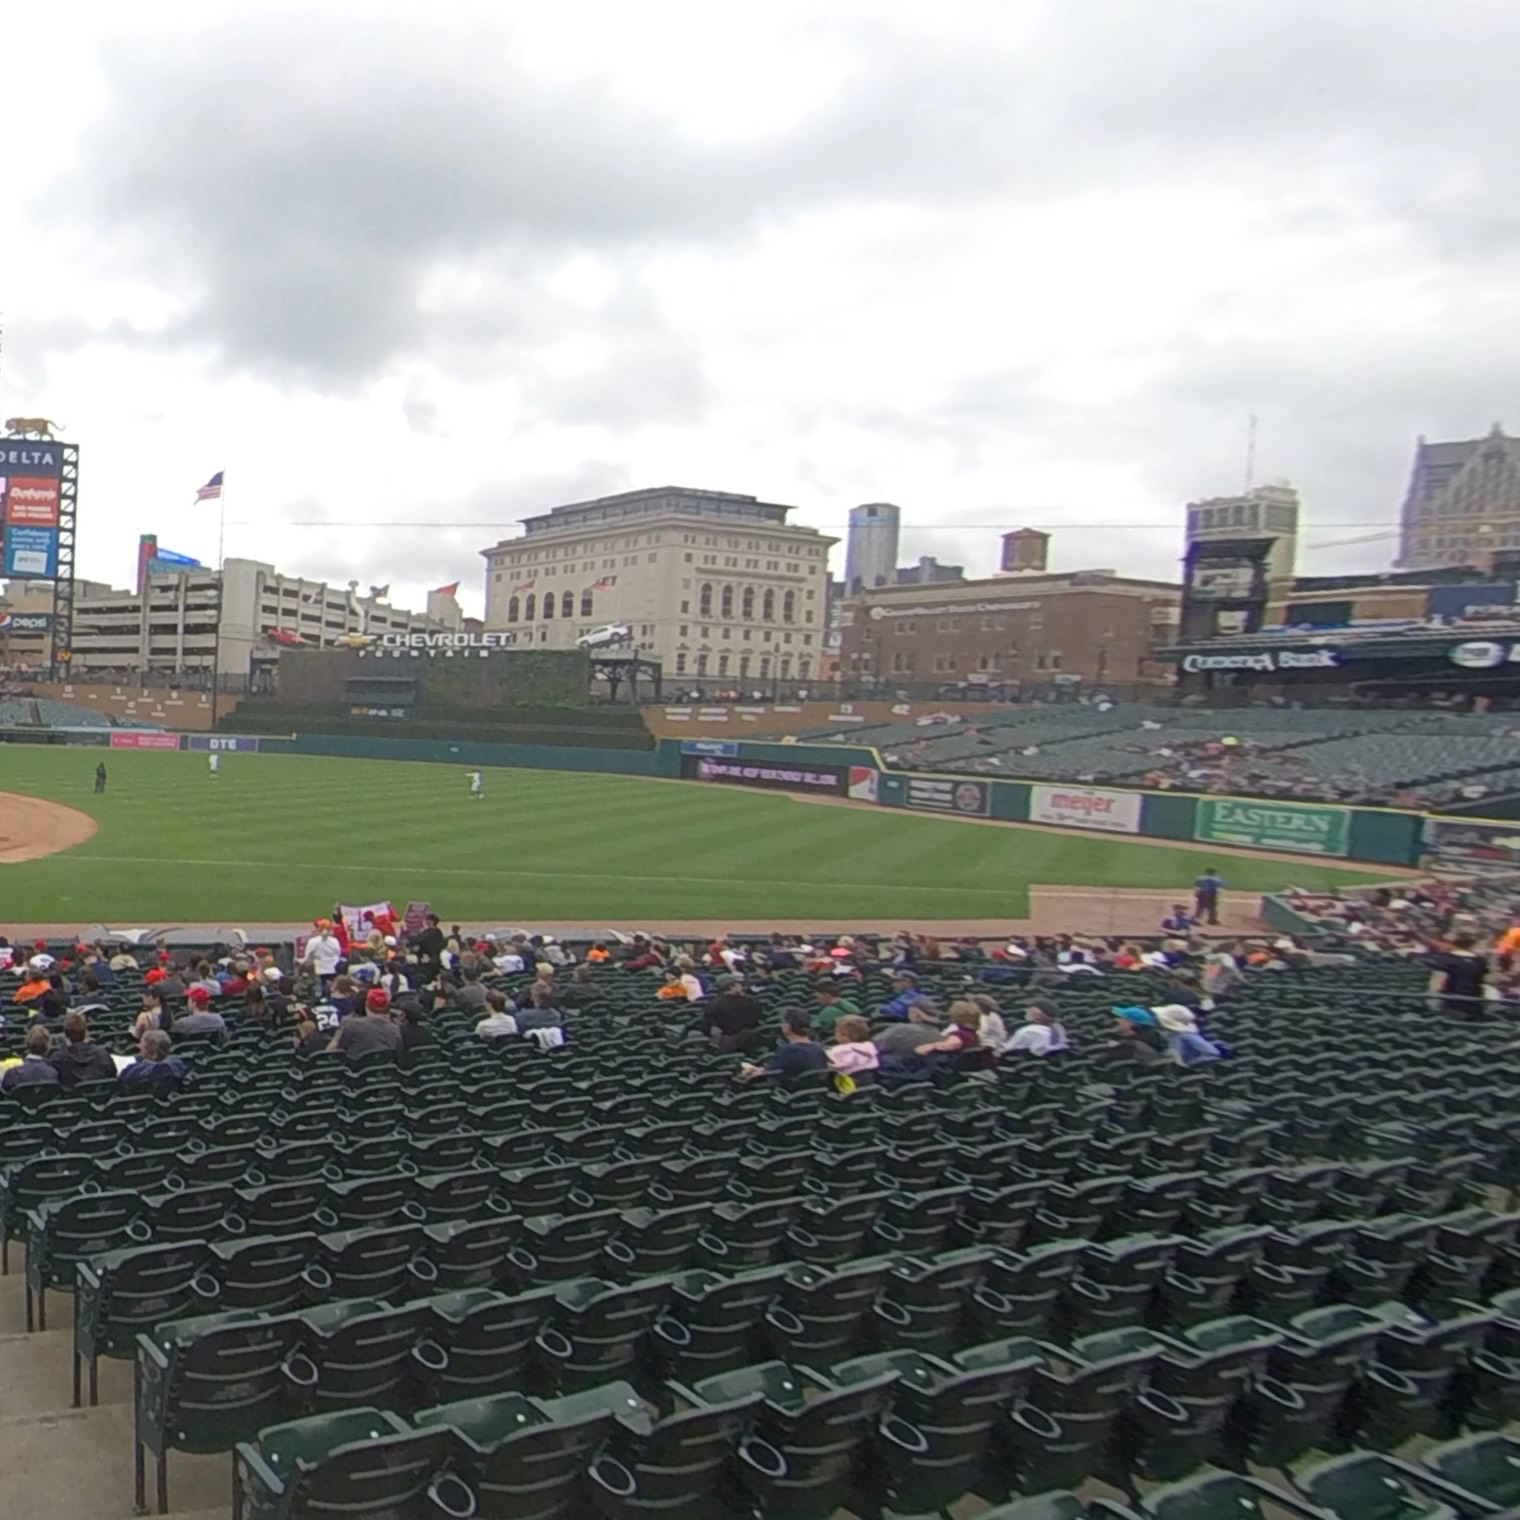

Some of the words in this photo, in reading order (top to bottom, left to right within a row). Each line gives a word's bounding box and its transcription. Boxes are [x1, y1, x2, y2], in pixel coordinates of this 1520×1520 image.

[12, 616, 48, 629] pepsi
[383, 632, 512, 648] CHEVROLET
[1279, 650, 1339, 668] Bank
[209, 738, 238, 750] DTE
[1050, 792, 1116, 816] meijer
[1214, 802, 1331, 832] EASTERN
[316, 1013, 340, 1031] 24
